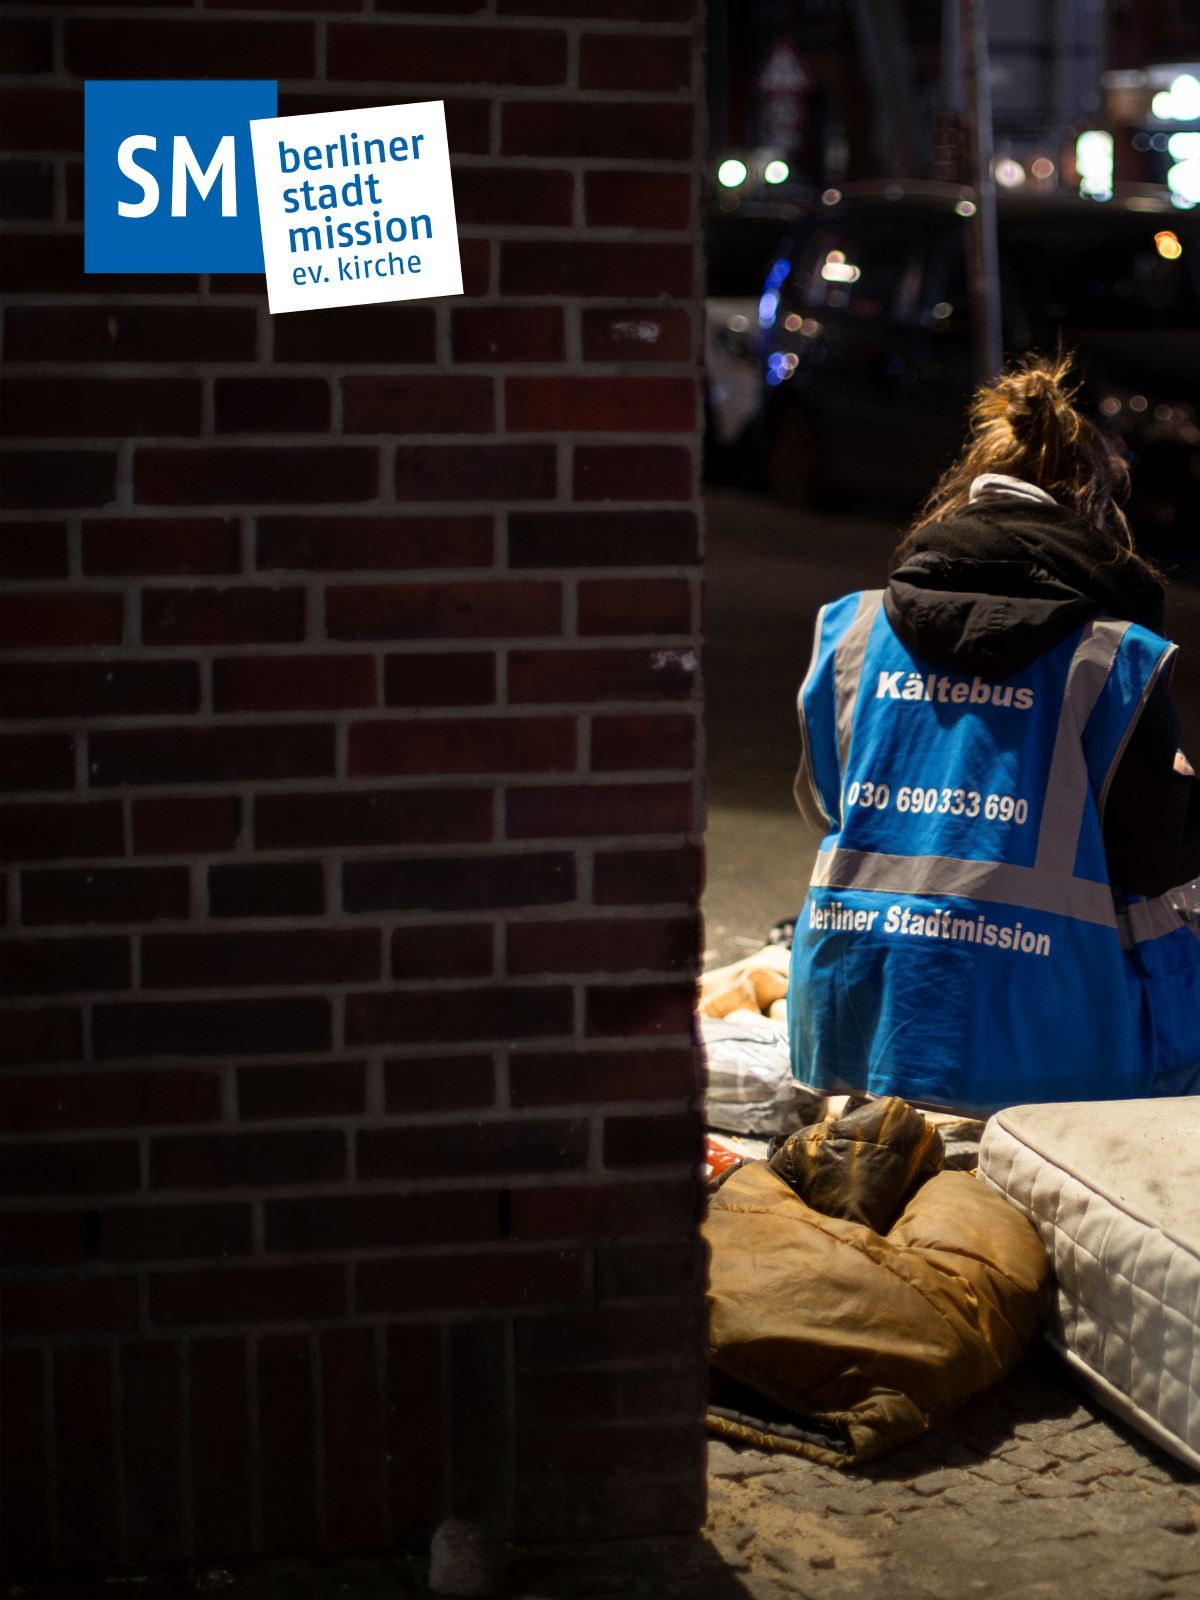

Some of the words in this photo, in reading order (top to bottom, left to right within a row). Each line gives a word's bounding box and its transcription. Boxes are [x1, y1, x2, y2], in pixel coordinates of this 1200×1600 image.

[876, 671, 1034, 709] Kältebus
[848, 781, 889, 810] 030
[809, 901, 879, 931] Berliner
[884, 905, 1051, 956] Stadtmission
